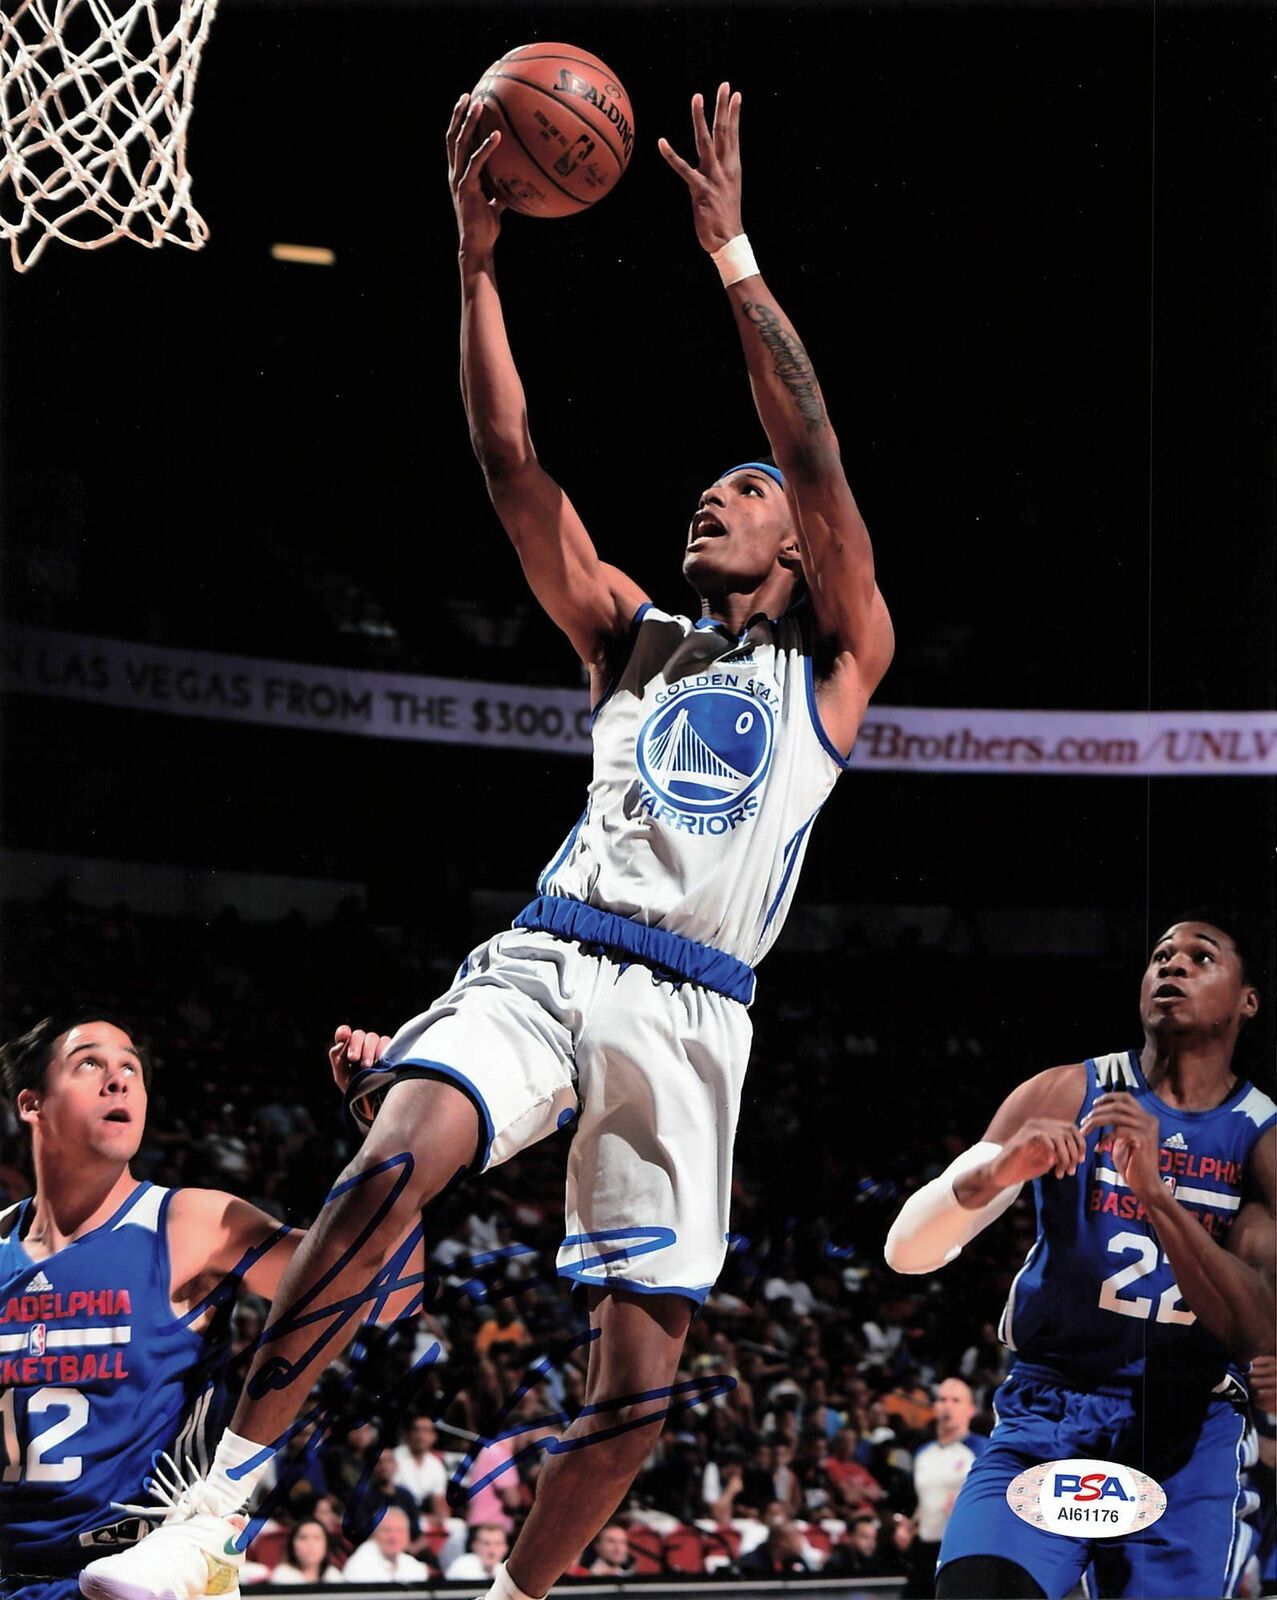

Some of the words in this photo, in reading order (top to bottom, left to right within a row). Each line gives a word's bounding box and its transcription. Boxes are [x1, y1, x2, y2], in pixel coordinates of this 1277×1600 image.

[553, 68, 633, 160] SPALDING
[37, 645, 110, 690] LAS
[124, 658, 250, 708] VEGAS
[264, 677, 373, 721] FROM
[384, 691, 458, 728] THE
[655, 673, 739, 704] GOLDEN
[744, 677, 779, 713] STAT
[735, 711, 754, 735] 0
[640, 781, 759, 835] ARRIORS
[1099, 1232, 1197, 1326] 22
[0, 1352, 128, 1384] KETBALL
[0, 1387, 89, 1482] 12
